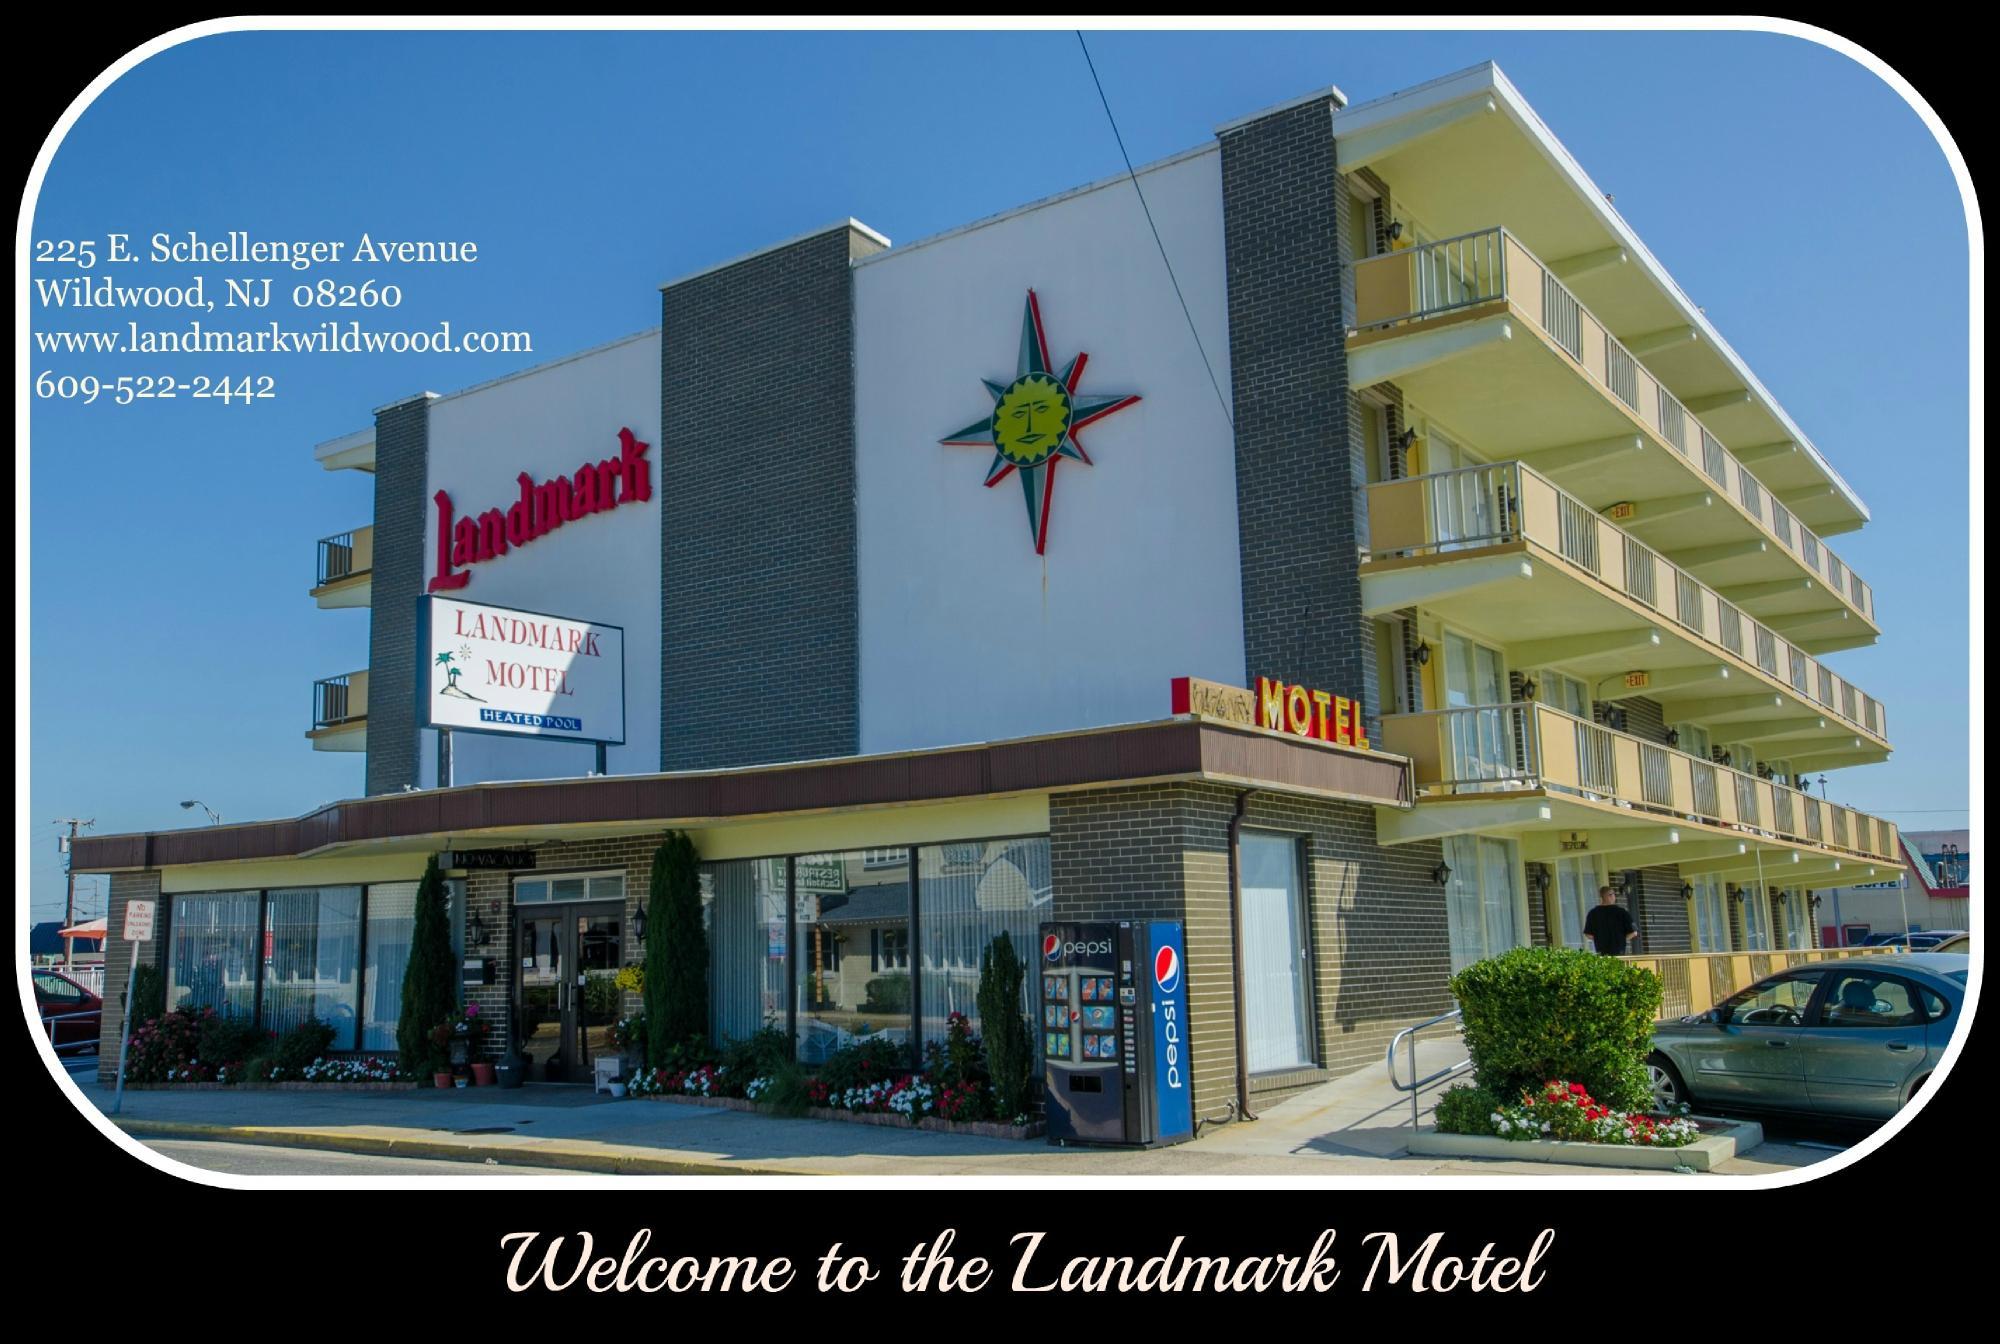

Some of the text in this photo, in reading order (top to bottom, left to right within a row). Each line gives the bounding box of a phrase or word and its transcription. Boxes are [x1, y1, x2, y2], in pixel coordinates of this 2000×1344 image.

[428, 427, 653, 593] Landmark
[455, 609, 601, 657] LANDMARK
[485, 659, 575, 697] MOTEL
[1630, 674, 1645, 687] EXIT
[483, 708, 580, 730] HEATED POOL
[1256, 676, 1370, 751] MOTEL
[1063, 938, 1113, 957] pepsi
[1161, 999, 1182, 1089] pepsi
